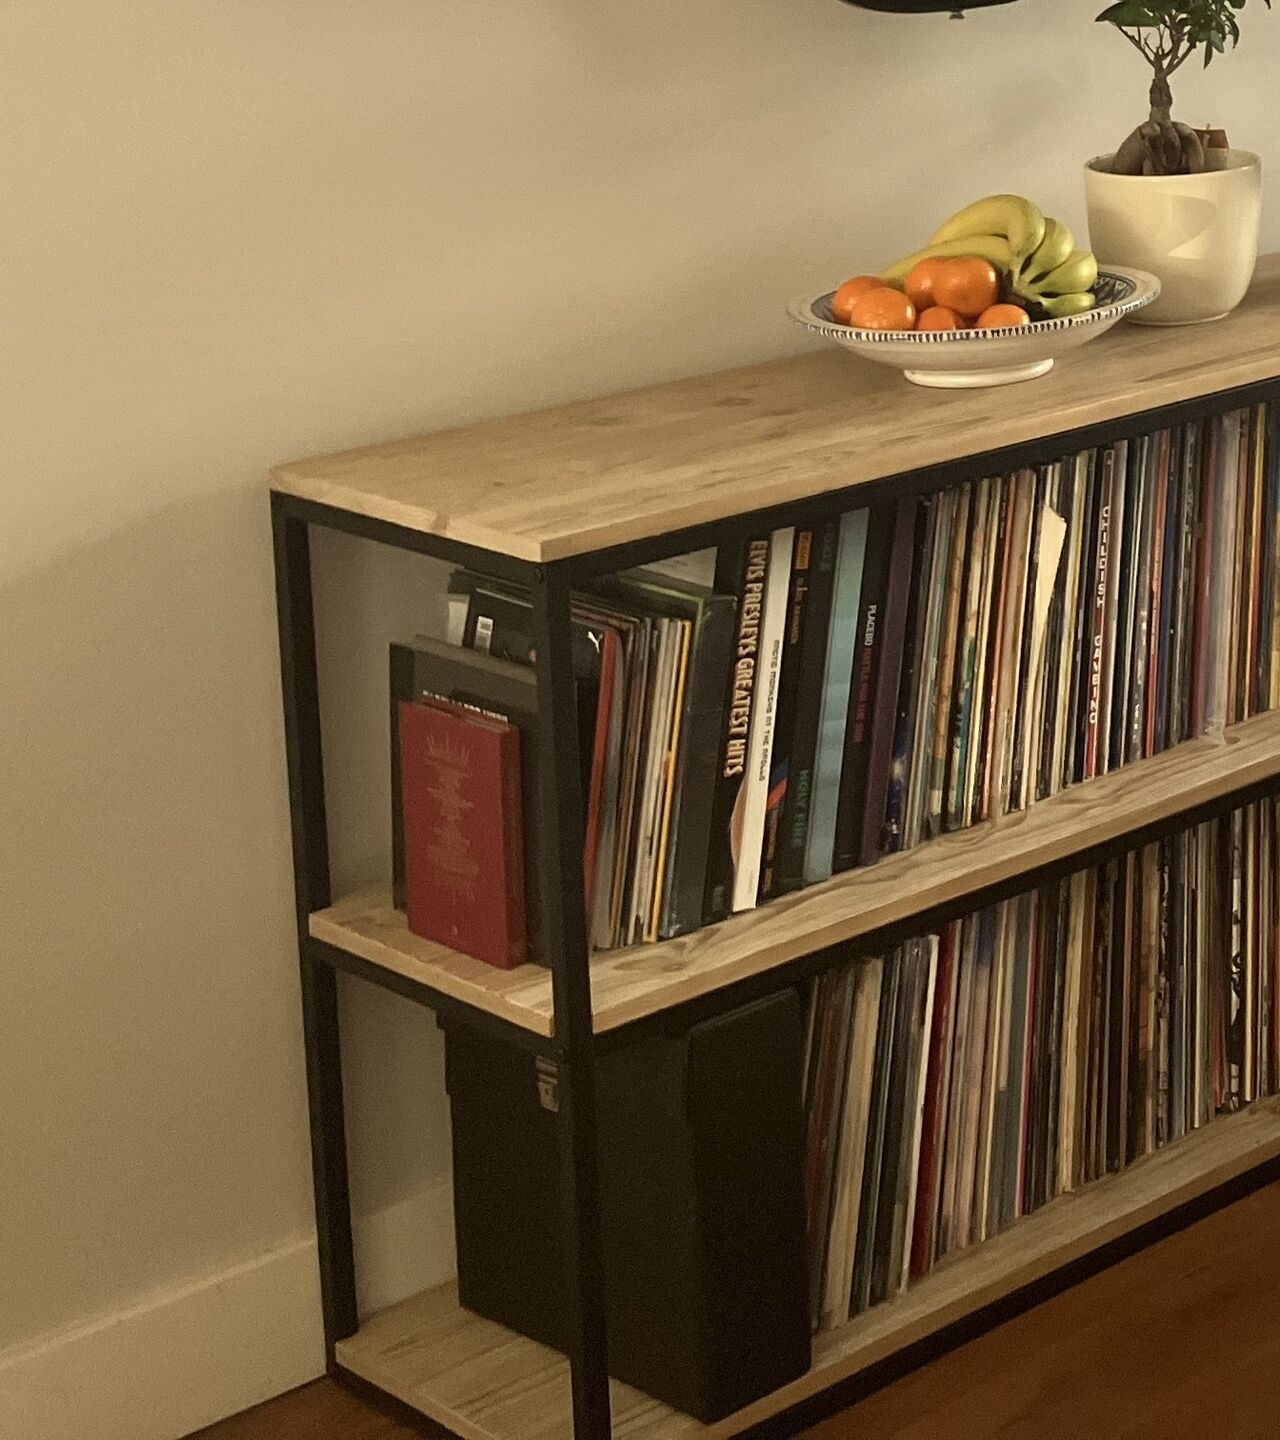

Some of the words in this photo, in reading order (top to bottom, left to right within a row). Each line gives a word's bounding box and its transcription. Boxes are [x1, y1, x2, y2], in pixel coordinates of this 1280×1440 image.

[746, 541, 768, 581] ELVIS
[1097, 506, 1110, 608] CHILDISH
[864, 605, 877, 646] PLACEBO
[728, 658, 755, 735] GREATEST
[1089, 635, 1103, 724] GAMBINO
[723, 739, 746, 778] HITS
